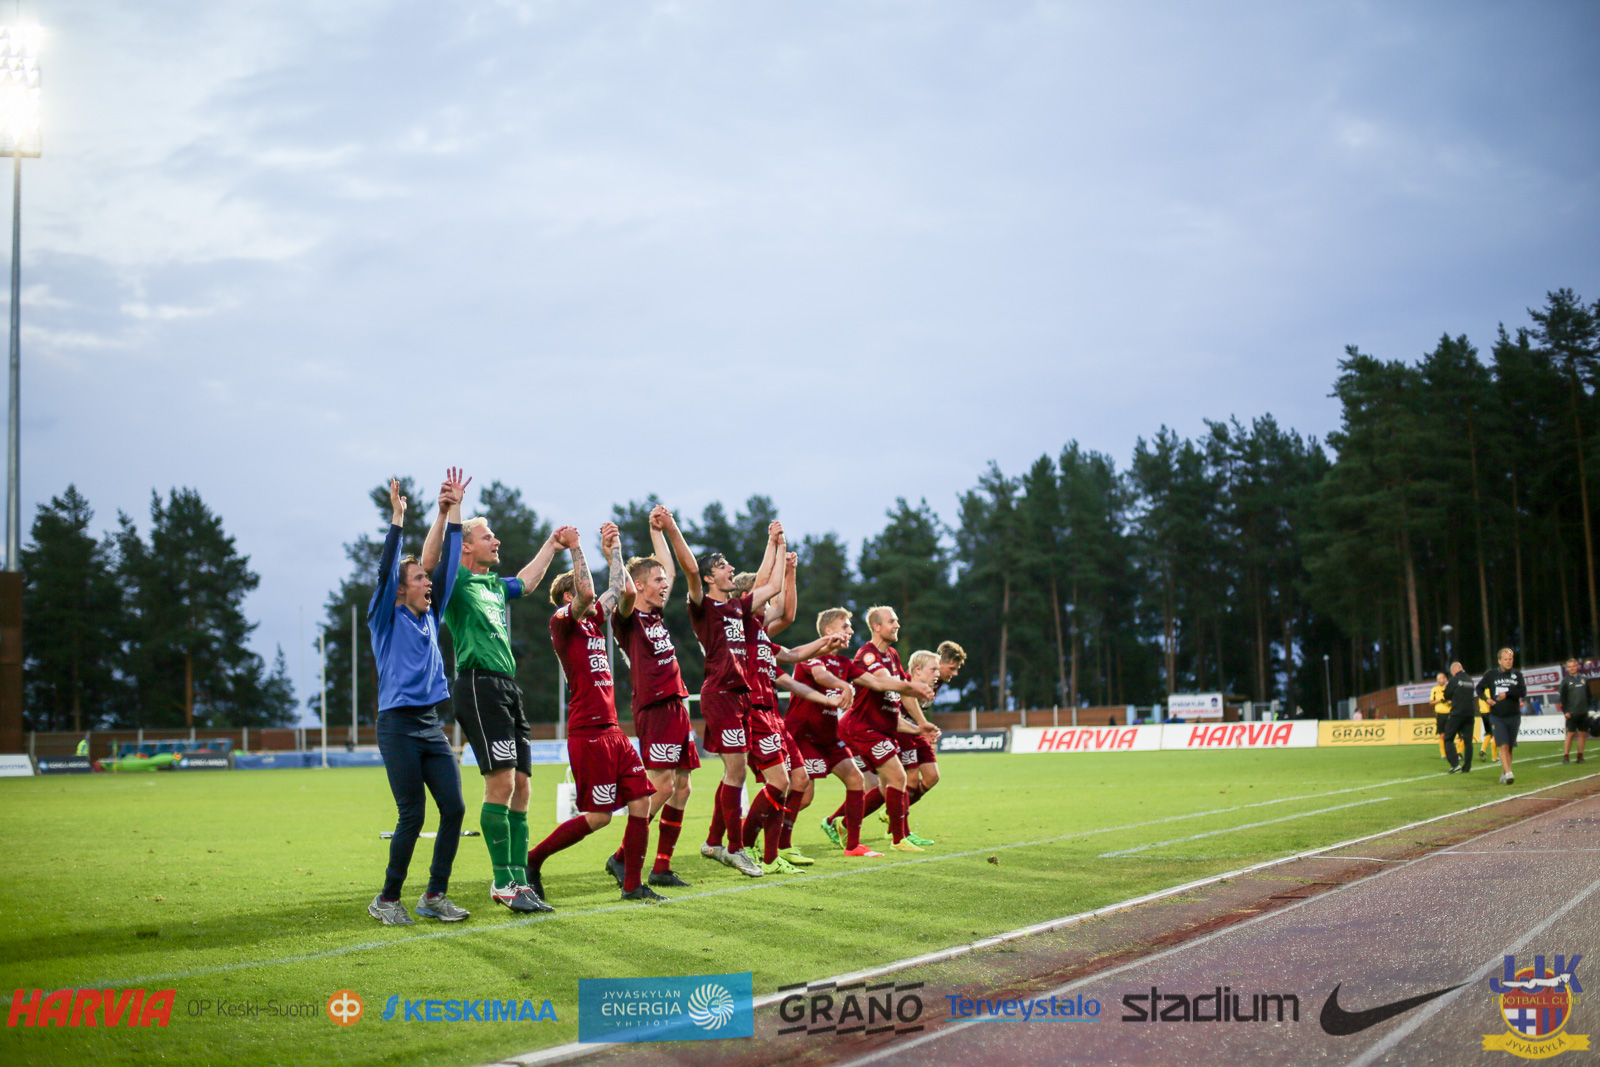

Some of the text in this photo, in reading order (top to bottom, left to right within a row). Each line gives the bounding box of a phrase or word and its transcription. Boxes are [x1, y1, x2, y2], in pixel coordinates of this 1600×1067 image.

[1526, 673, 1557, 685] BERG
[1187, 723, 1293, 747] HARVIA
[1332, 727, 1385, 739] GRANO
[1518, 727, 1565, 736] AKKONEN
[940, 734, 1004, 750] stadium
[1037, 728, 1138, 751] HARVIA
